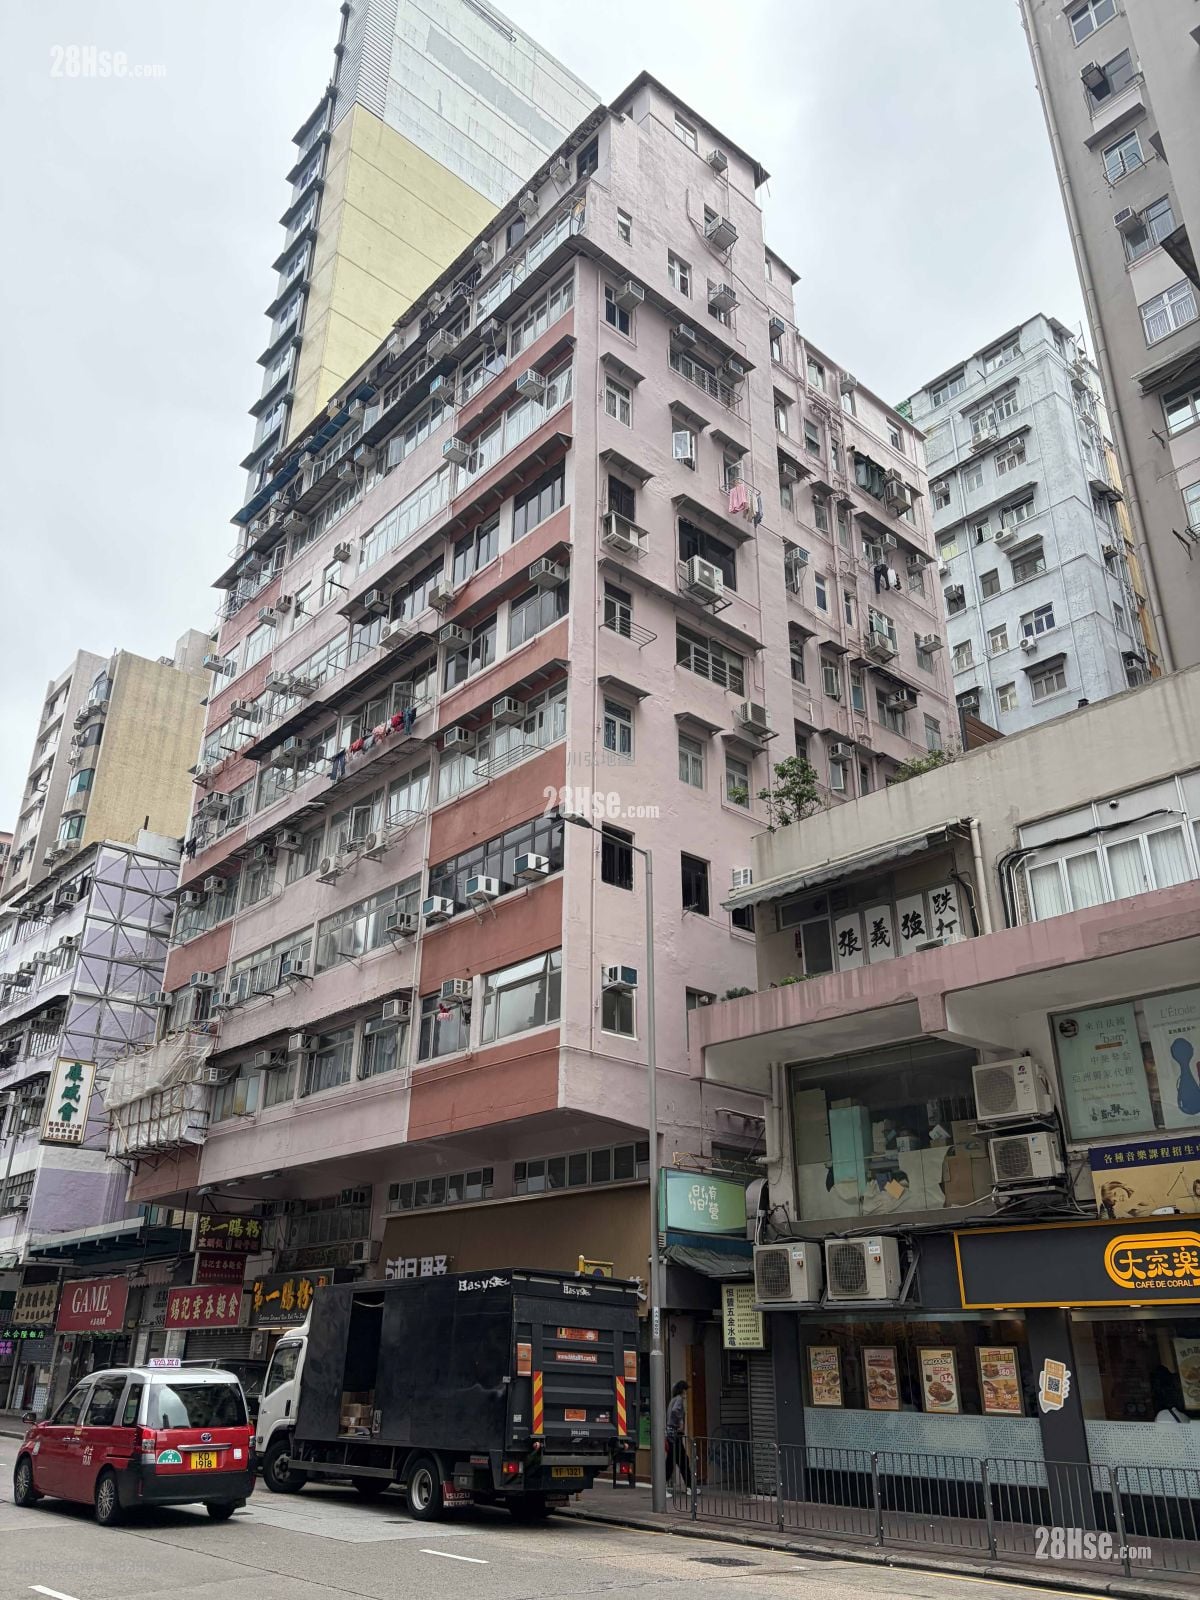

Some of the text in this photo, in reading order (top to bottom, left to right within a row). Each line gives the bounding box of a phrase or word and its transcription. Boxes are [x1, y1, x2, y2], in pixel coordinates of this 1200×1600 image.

[932, 888, 958, 937] 跌打
[838, 910, 925, 957] 張義強
[1135, 1279, 1194, 1289] CAFÉ DE CORAL
[72, 1285, 111, 1313] GAME
[153, 1359, 180, 1367] TAXI
[198, 1452, 210, 1460] KD
[195, 1459, 213, 1469] 1918
[446, 1491, 471, 1499] ISUZU
